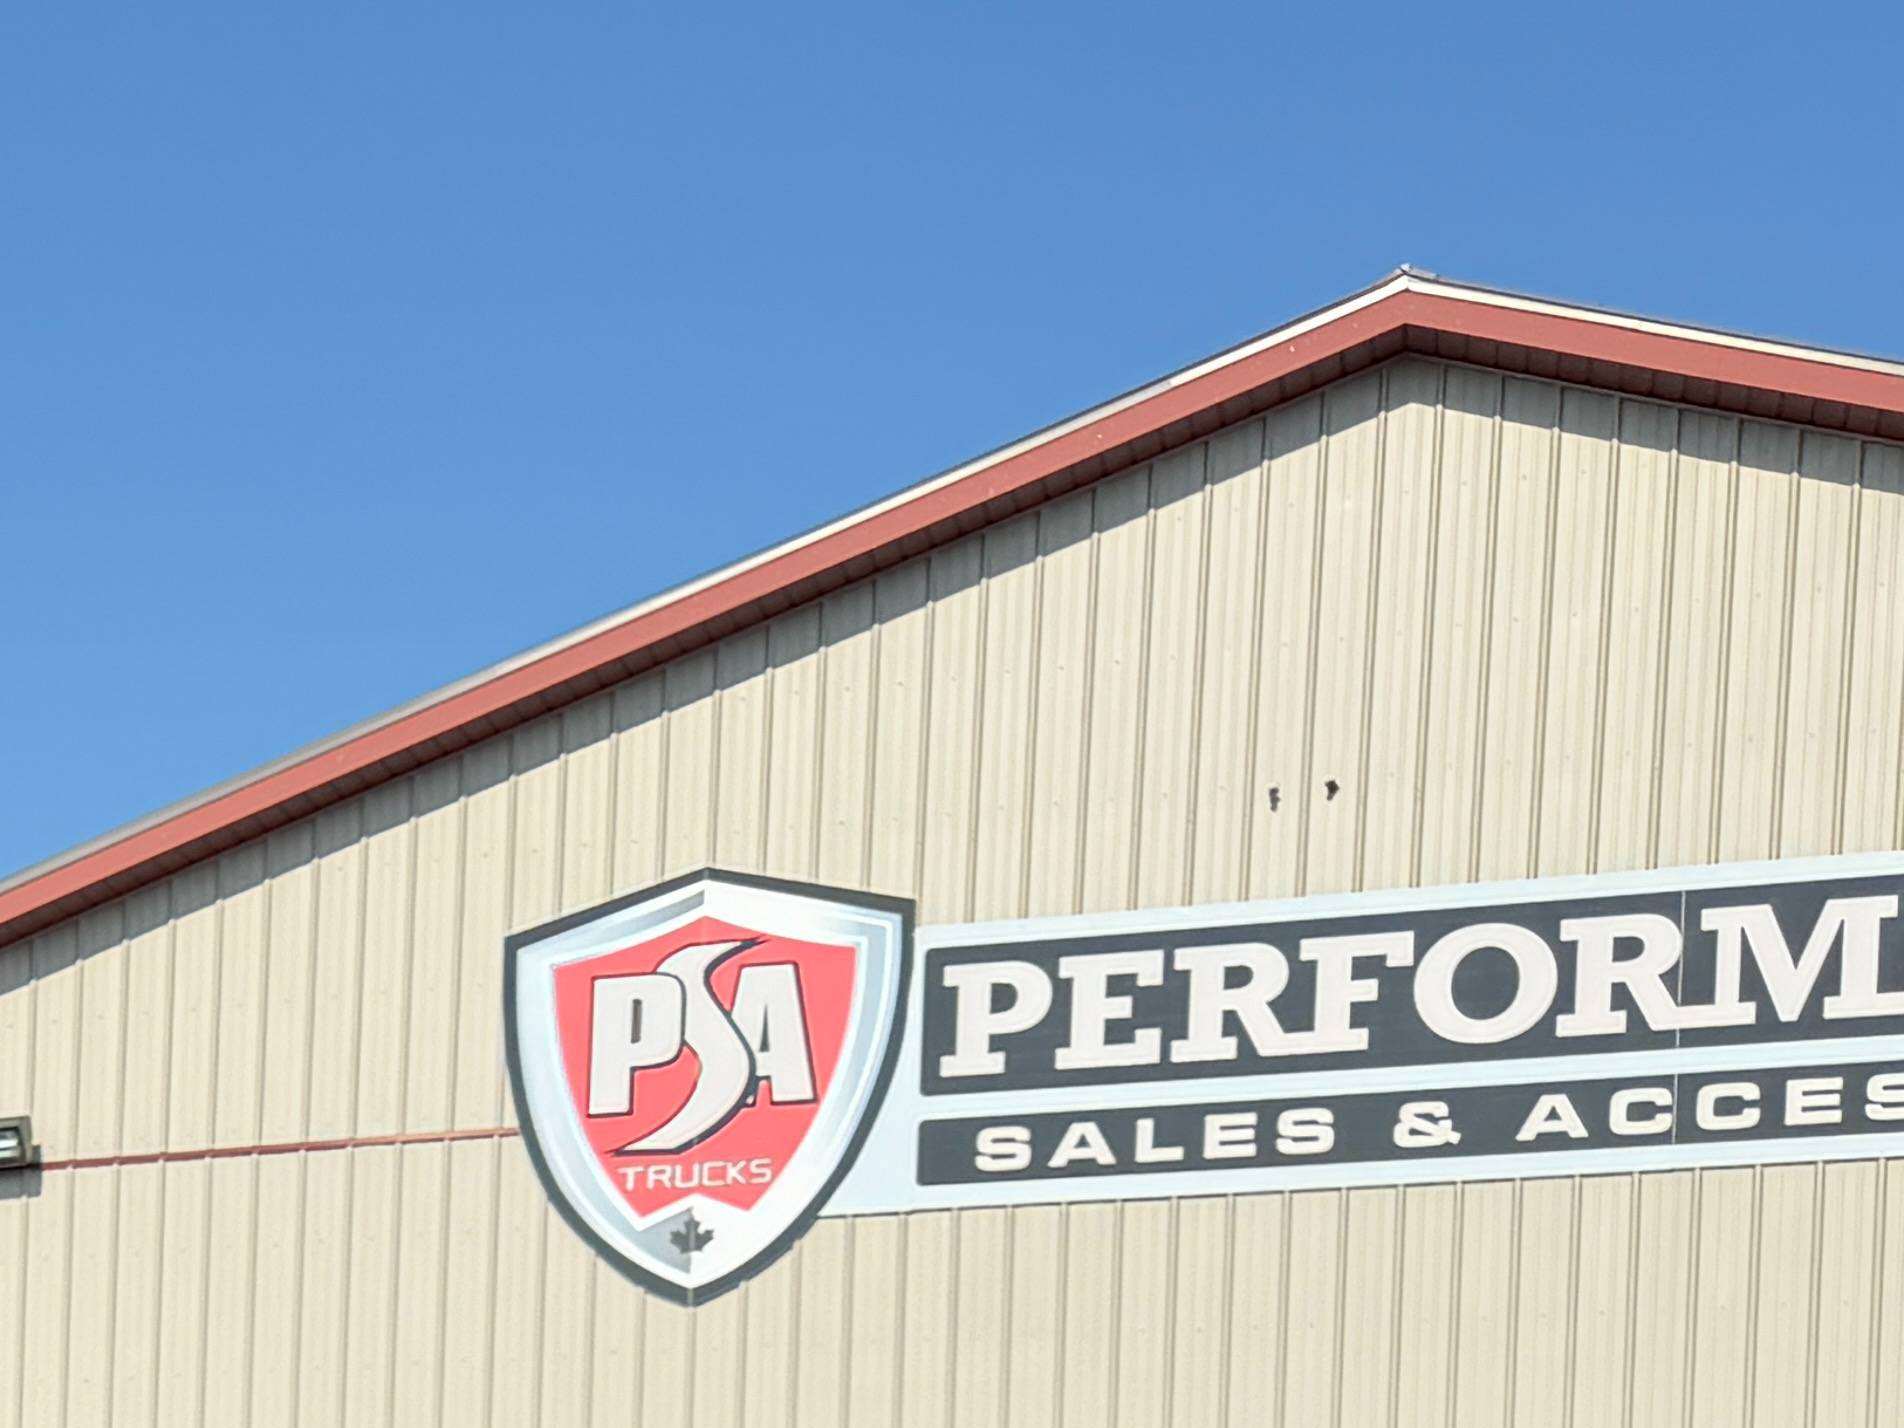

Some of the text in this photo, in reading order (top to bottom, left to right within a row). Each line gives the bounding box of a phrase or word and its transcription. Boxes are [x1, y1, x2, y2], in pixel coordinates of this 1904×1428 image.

[585, 937, 819, 1155] PSA
[939, 895, 1904, 1078] PERFORM
[618, 1158, 775, 1192] TRUCKS
[974, 1107, 1335, 1172] SALES
[1394, 1100, 1461, 1148] &
